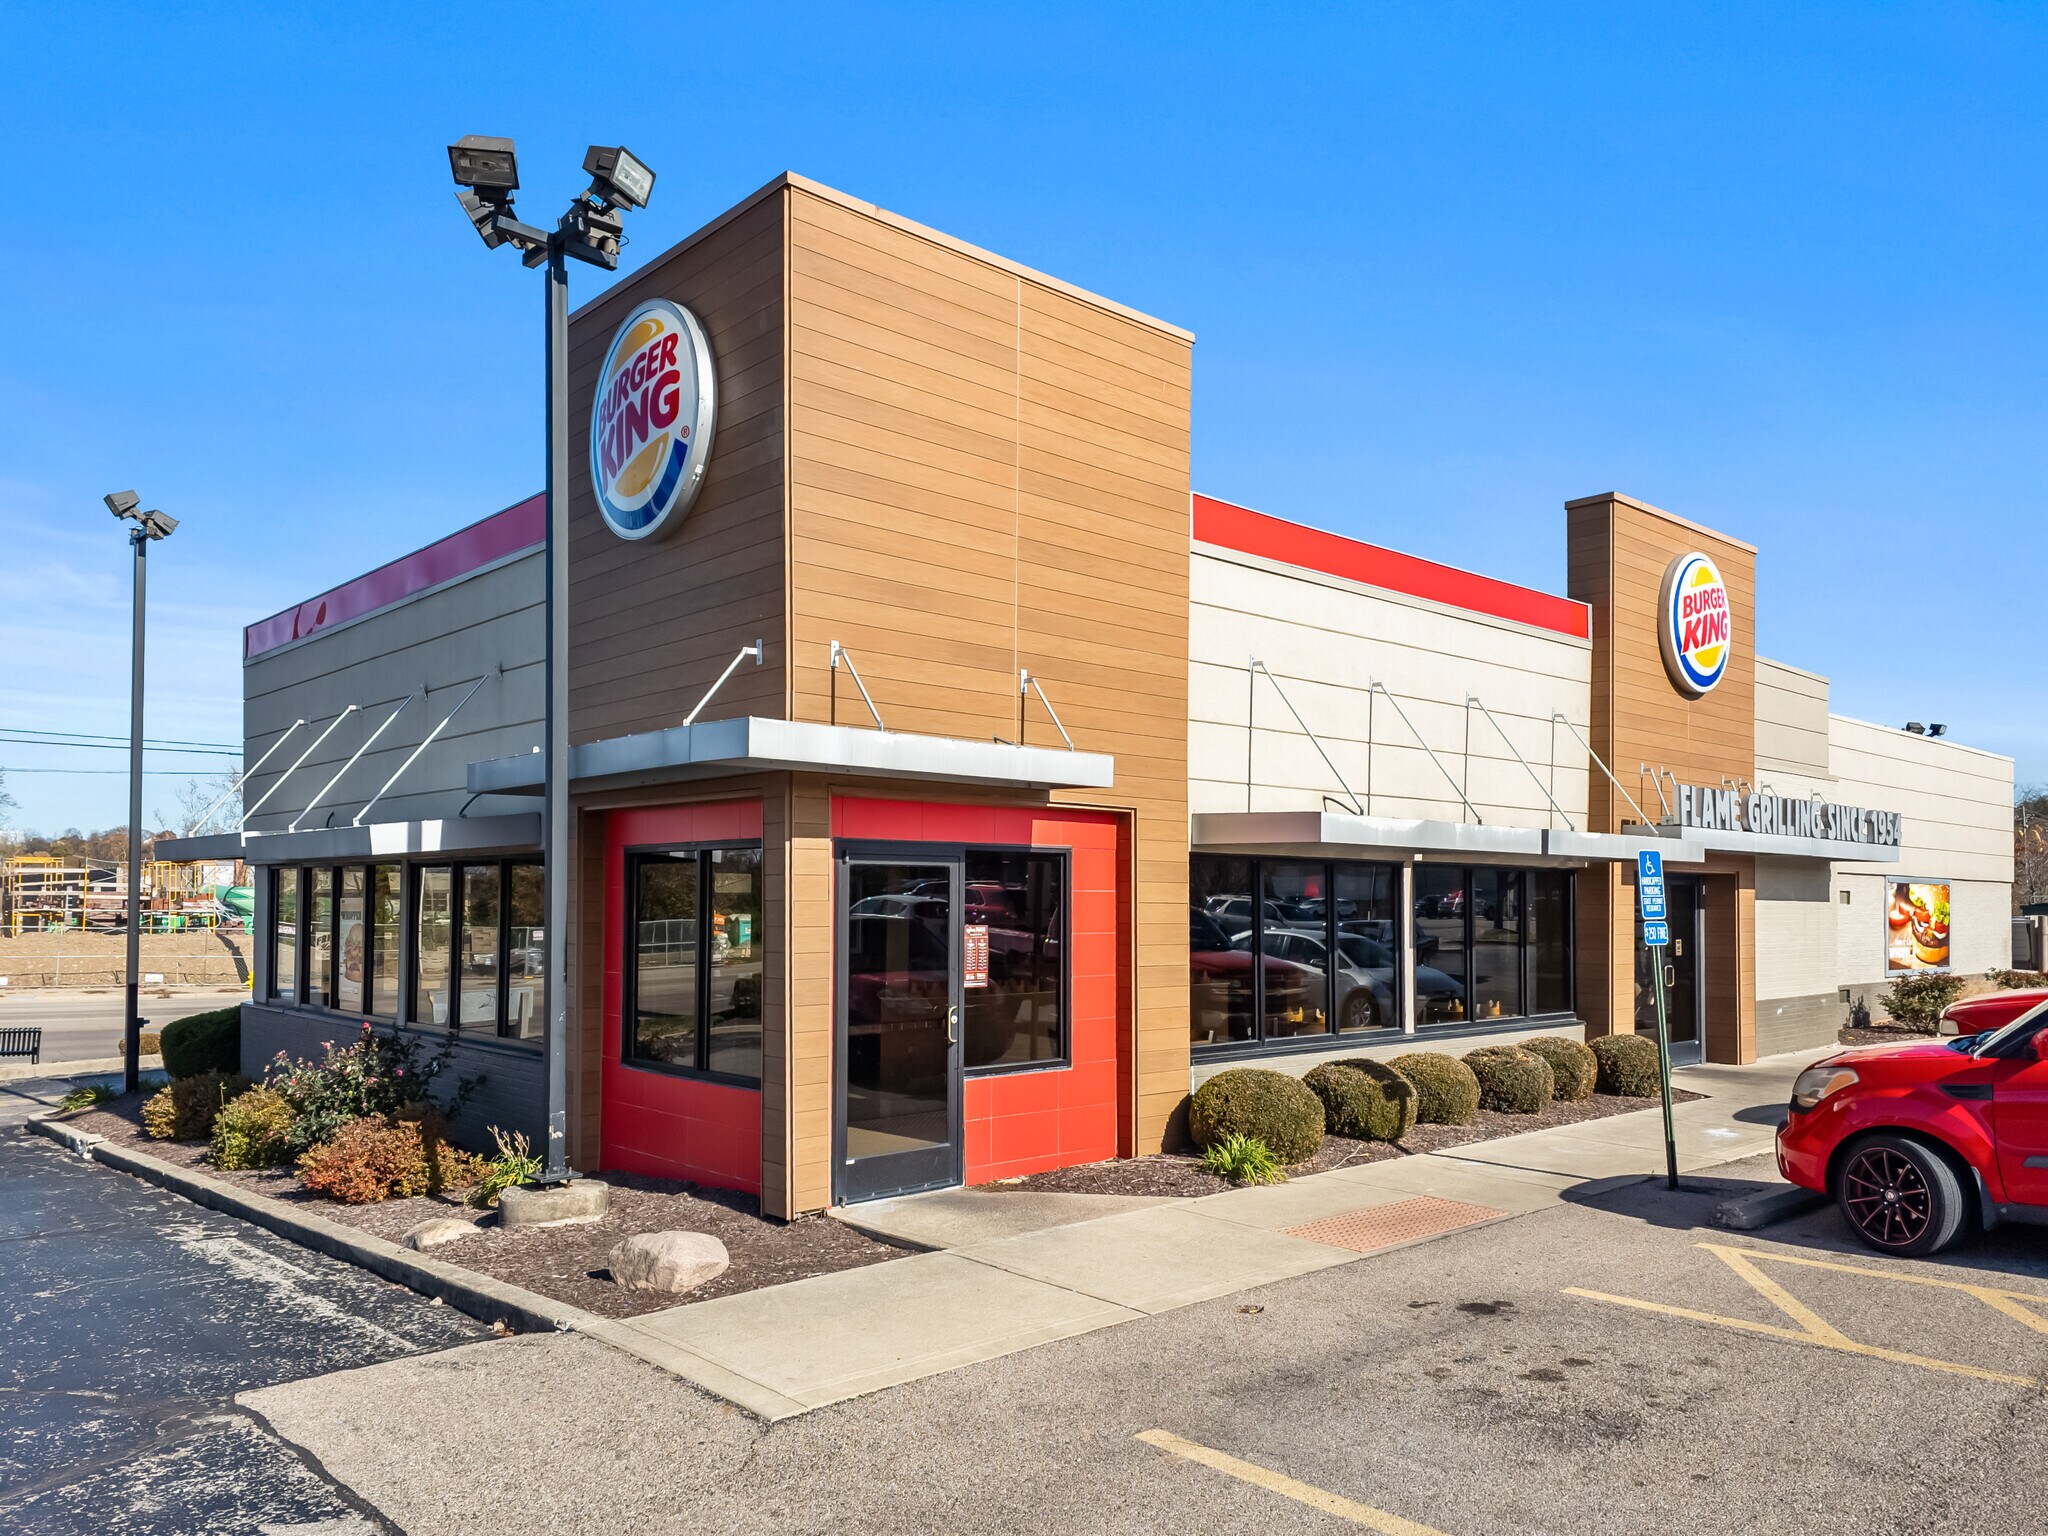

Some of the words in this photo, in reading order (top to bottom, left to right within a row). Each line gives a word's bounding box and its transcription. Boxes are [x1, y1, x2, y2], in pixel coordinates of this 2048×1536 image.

[598, 332, 679, 442] BURGER
[600, 369, 681, 498] KING
[1682, 587, 1727, 619] BURGER
[1681, 610, 1728, 653] KING
[1678, 784, 1742, 831] FLAME
[1747, 793, 1822, 839] GRILLING
[1826, 802, 1868, 843] SINCE
[1871, 809, 1902, 846] 1954
[1643, 886, 1661, 895] PARKING
[1656, 926, 1667, 940] FINE
